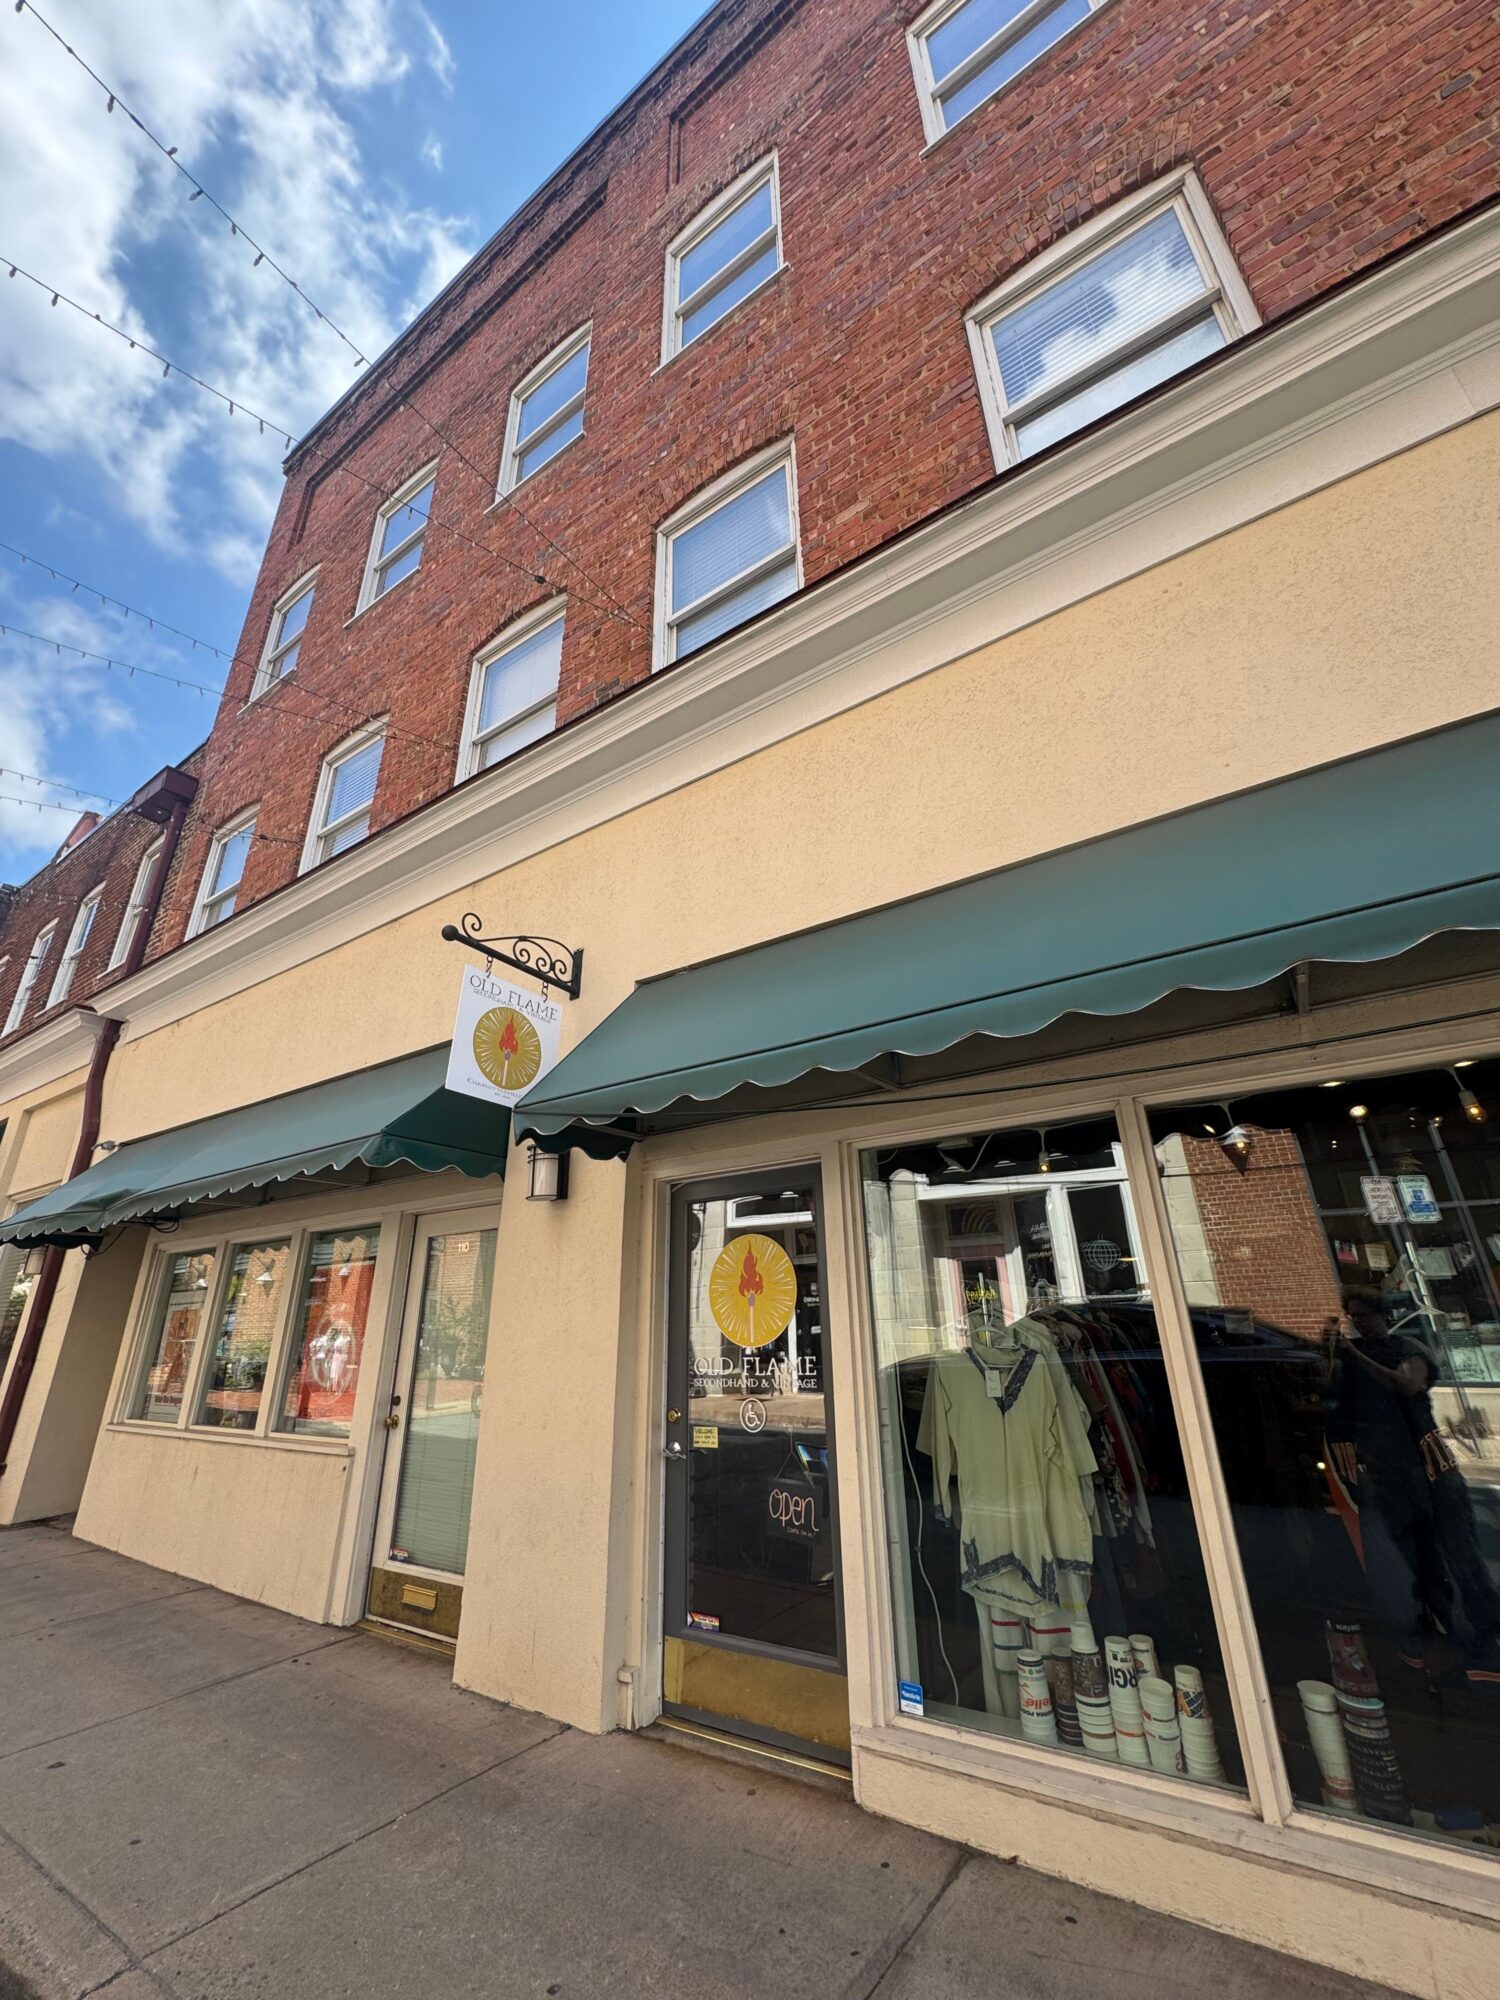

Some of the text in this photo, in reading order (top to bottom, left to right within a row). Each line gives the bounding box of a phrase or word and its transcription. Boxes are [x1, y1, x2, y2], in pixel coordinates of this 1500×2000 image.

[470, 975, 559, 1021] OLD FLAME
[458, 1242, 470, 1253] 110
[693, 1356, 817, 1376] OLD FLAME
[693, 1378, 759, 1388] SECONDHAND
[761, 1379, 770, 1388] &
